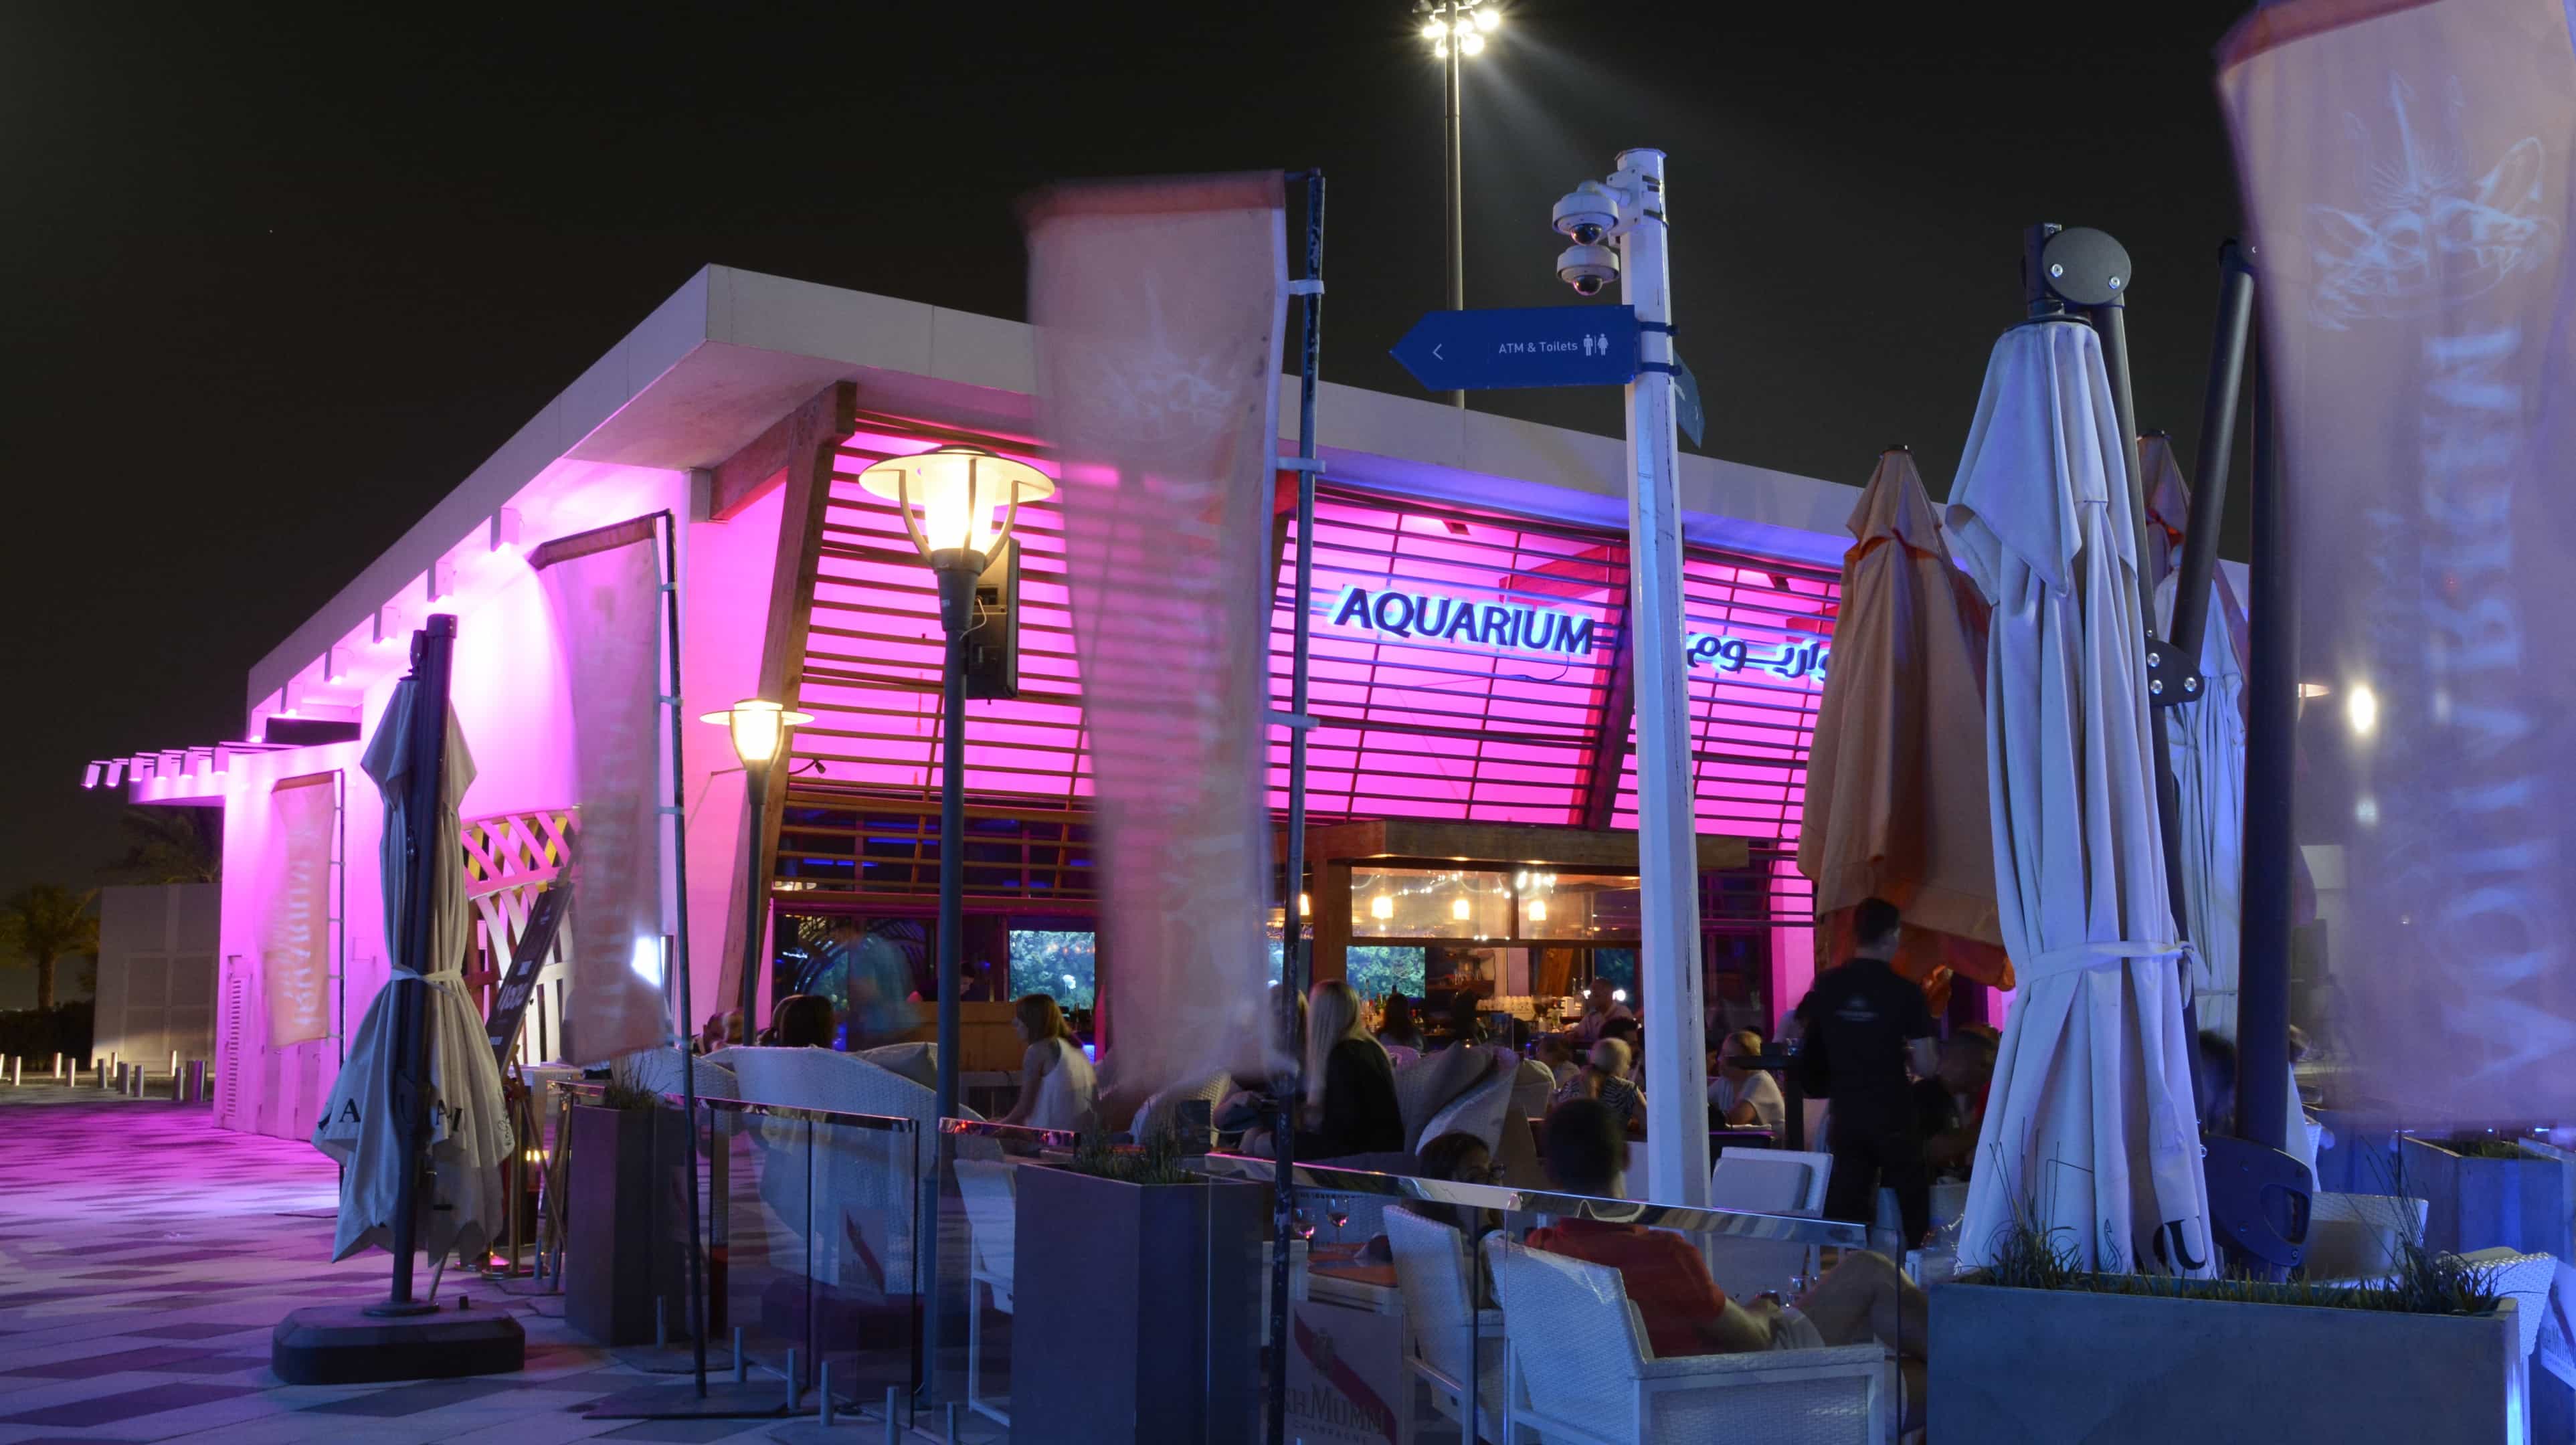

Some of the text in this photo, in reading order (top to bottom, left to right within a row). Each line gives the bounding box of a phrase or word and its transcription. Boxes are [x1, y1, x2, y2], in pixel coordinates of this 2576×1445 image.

[1498, 341, 1578, 354] ATM & Toilets
[1333, 587, 1594, 655] AQUARIUM
